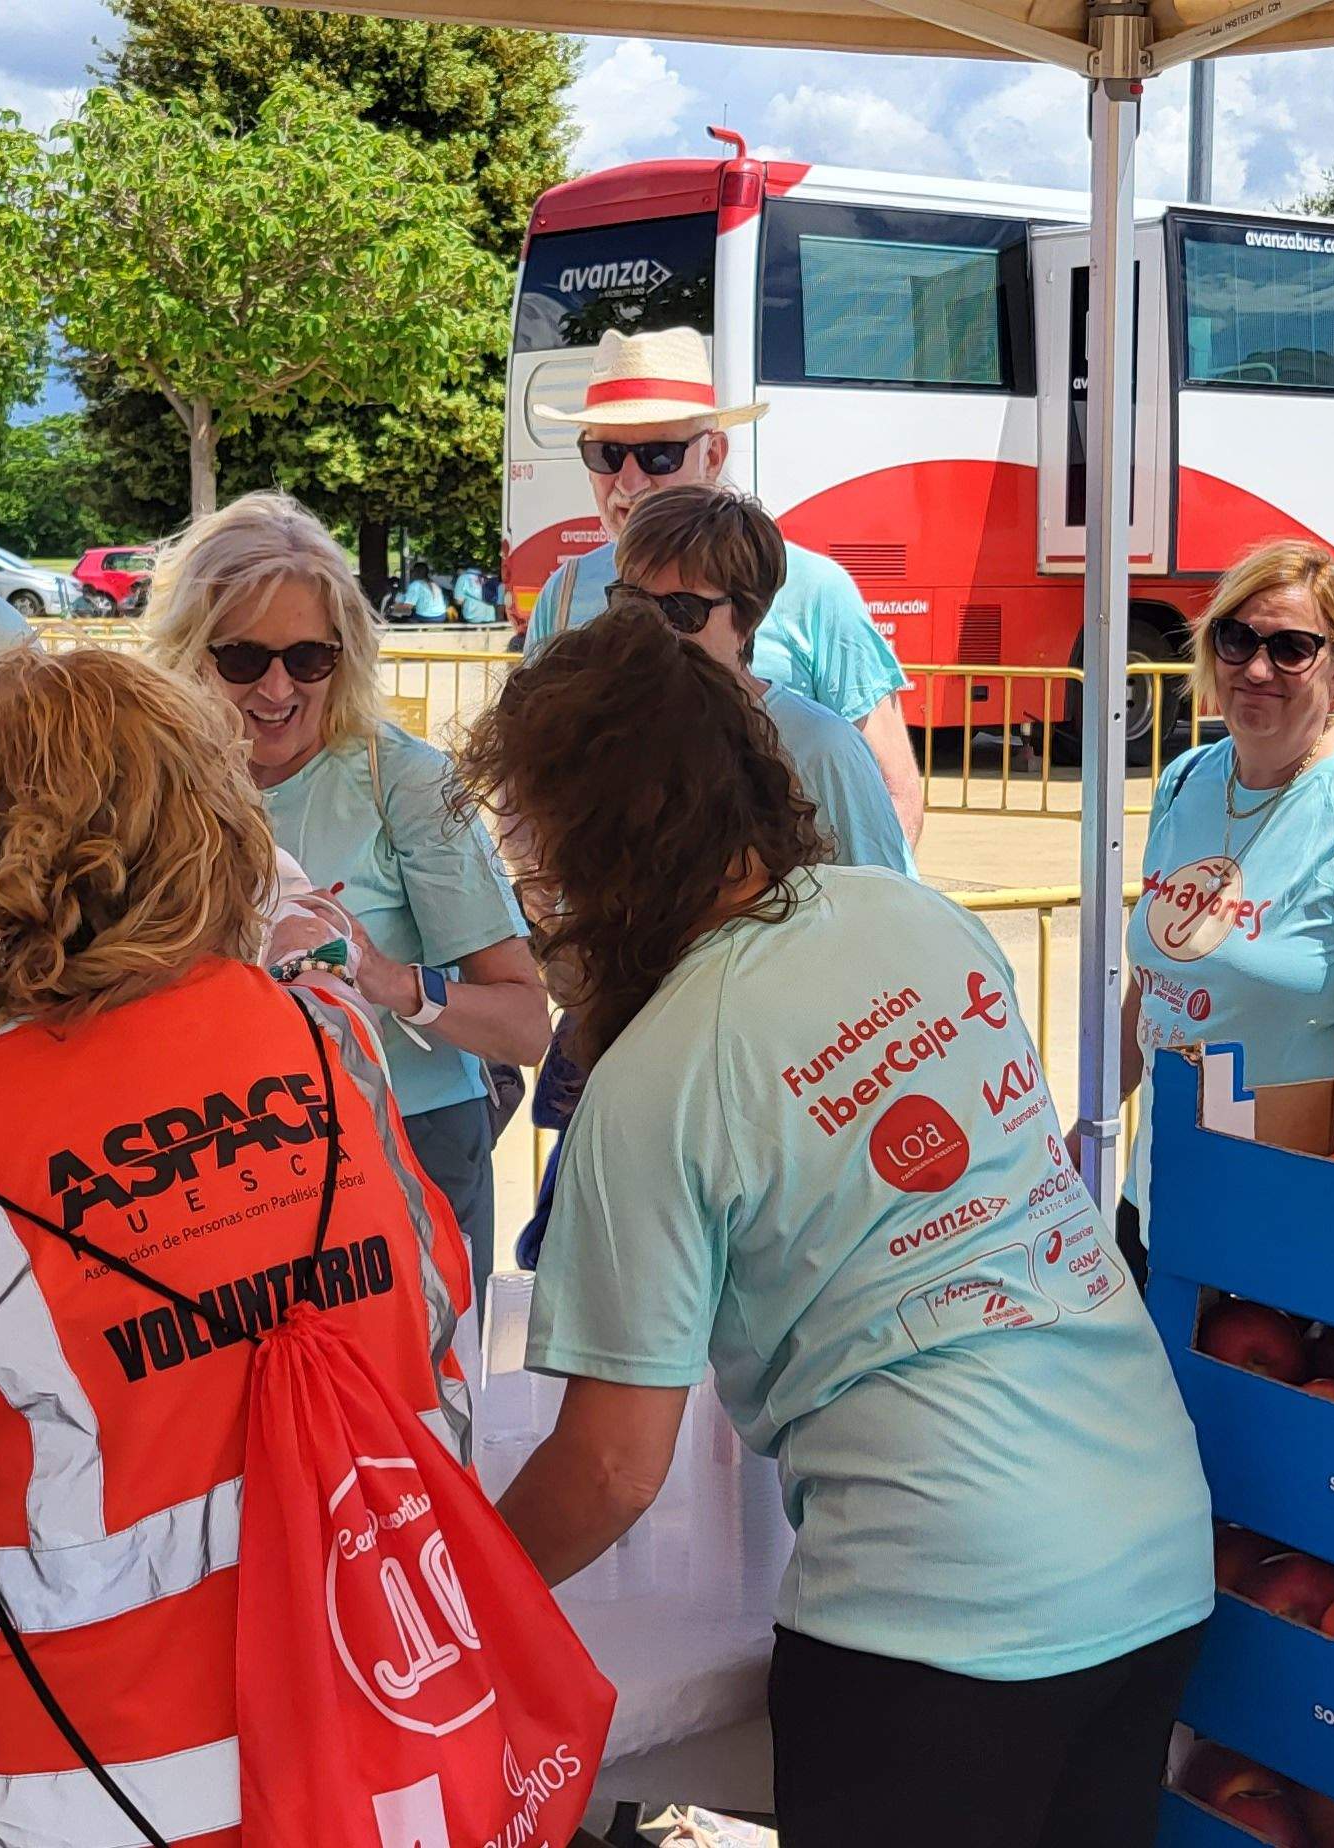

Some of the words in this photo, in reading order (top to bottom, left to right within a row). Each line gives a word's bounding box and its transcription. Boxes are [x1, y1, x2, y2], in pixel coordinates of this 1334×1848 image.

[559, 259, 649, 293] avanza
[782, 986, 923, 1098] Fundación
[49, 1072, 343, 1231] ASPACE
[162, 1233, 181, 1250] de
[181, 1210, 243, 1242] Personas
[245, 1202, 269, 1218] con
[270, 1185, 319, 1210] Parálisis
[889, 1198, 987, 1257] avanza
[103, 1234, 395, 1384] VOLUNTARIO
